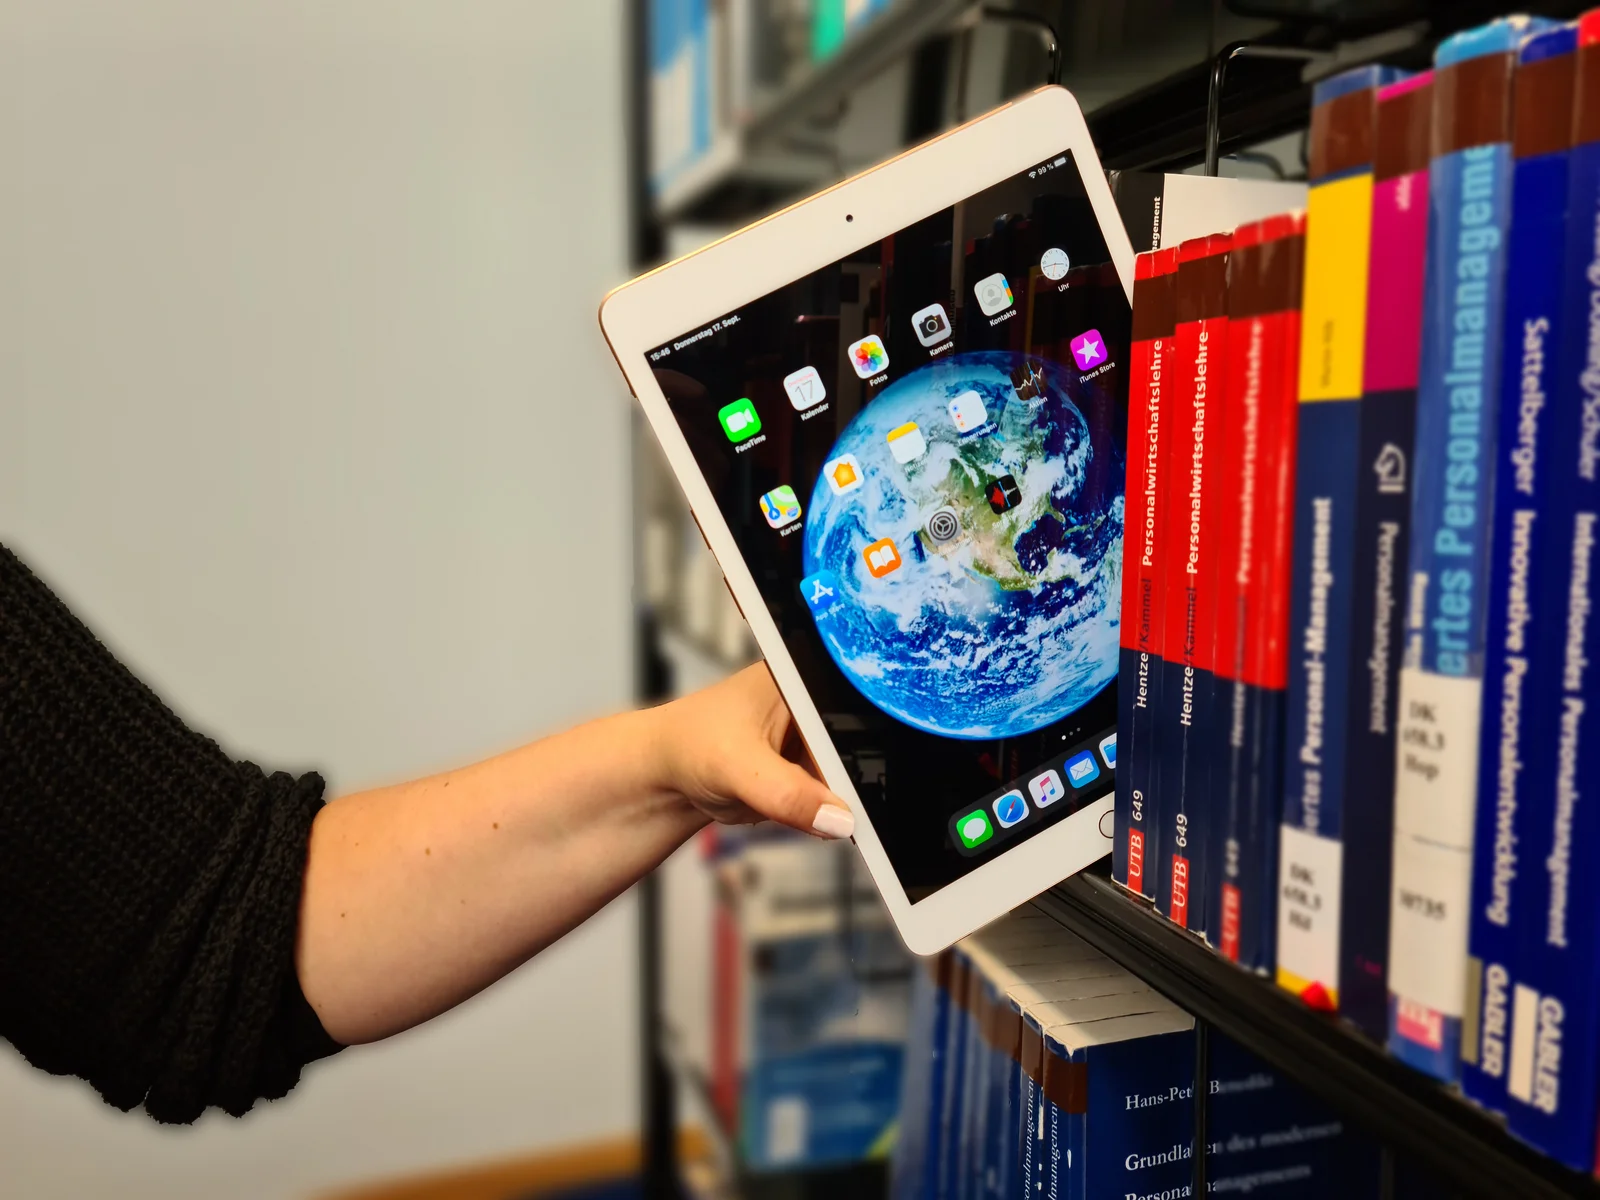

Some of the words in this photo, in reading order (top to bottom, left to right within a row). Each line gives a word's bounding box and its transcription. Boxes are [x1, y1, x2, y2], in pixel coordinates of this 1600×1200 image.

[1037, 166, 1047, 175] 99
[1057, 283, 1070, 292] Uhr
[989, 308, 1017, 327] Kontakte
[650, 347, 671, 361] 15:46
[673, 328, 713, 351] Donnerstag
[721, 315, 741, 328] Sept.
[929, 341, 954, 357] Kamera
[869, 374, 888, 387] Fotos
[1079, 370, 1100, 384] iTunes
[1098, 361, 1116, 375] Store
[794, 380, 813, 402] 17
[1028, 396, 1048, 410] Aktien
[1511, 318, 1549, 495] Sattelberger
[800, 403, 829, 421] Kalender
[735, 434, 766, 453] FaceTime
[1143, 340, 1163, 566] Personalwirtschaftslehre
[1187, 331, 1209, 574] Personalwirtschaftslehre
[780, 522, 803, 537] Karten
[1506, 511, 1536, 652] Innovative
[1562, 512, 1597, 690] Internationales
[1299, 497, 1334, 765] Personal-Management
[1132, 789, 1144, 821] 649
[1485, 657, 1528, 925] Personalentwicklung
[1175, 813, 1188, 848] 649
[1547, 697, 1584, 947] Personalmanagement
[1129, 834, 1142, 878] UTB
[1172, 861, 1187, 908] UTB
[1481, 963, 1510, 1077] GABLER
[1532, 995, 1564, 1115] GABLER
[1125, 1080, 1195, 1111] Hans-Pet
[1125, 1141, 1222, 1171] Grundlaen
